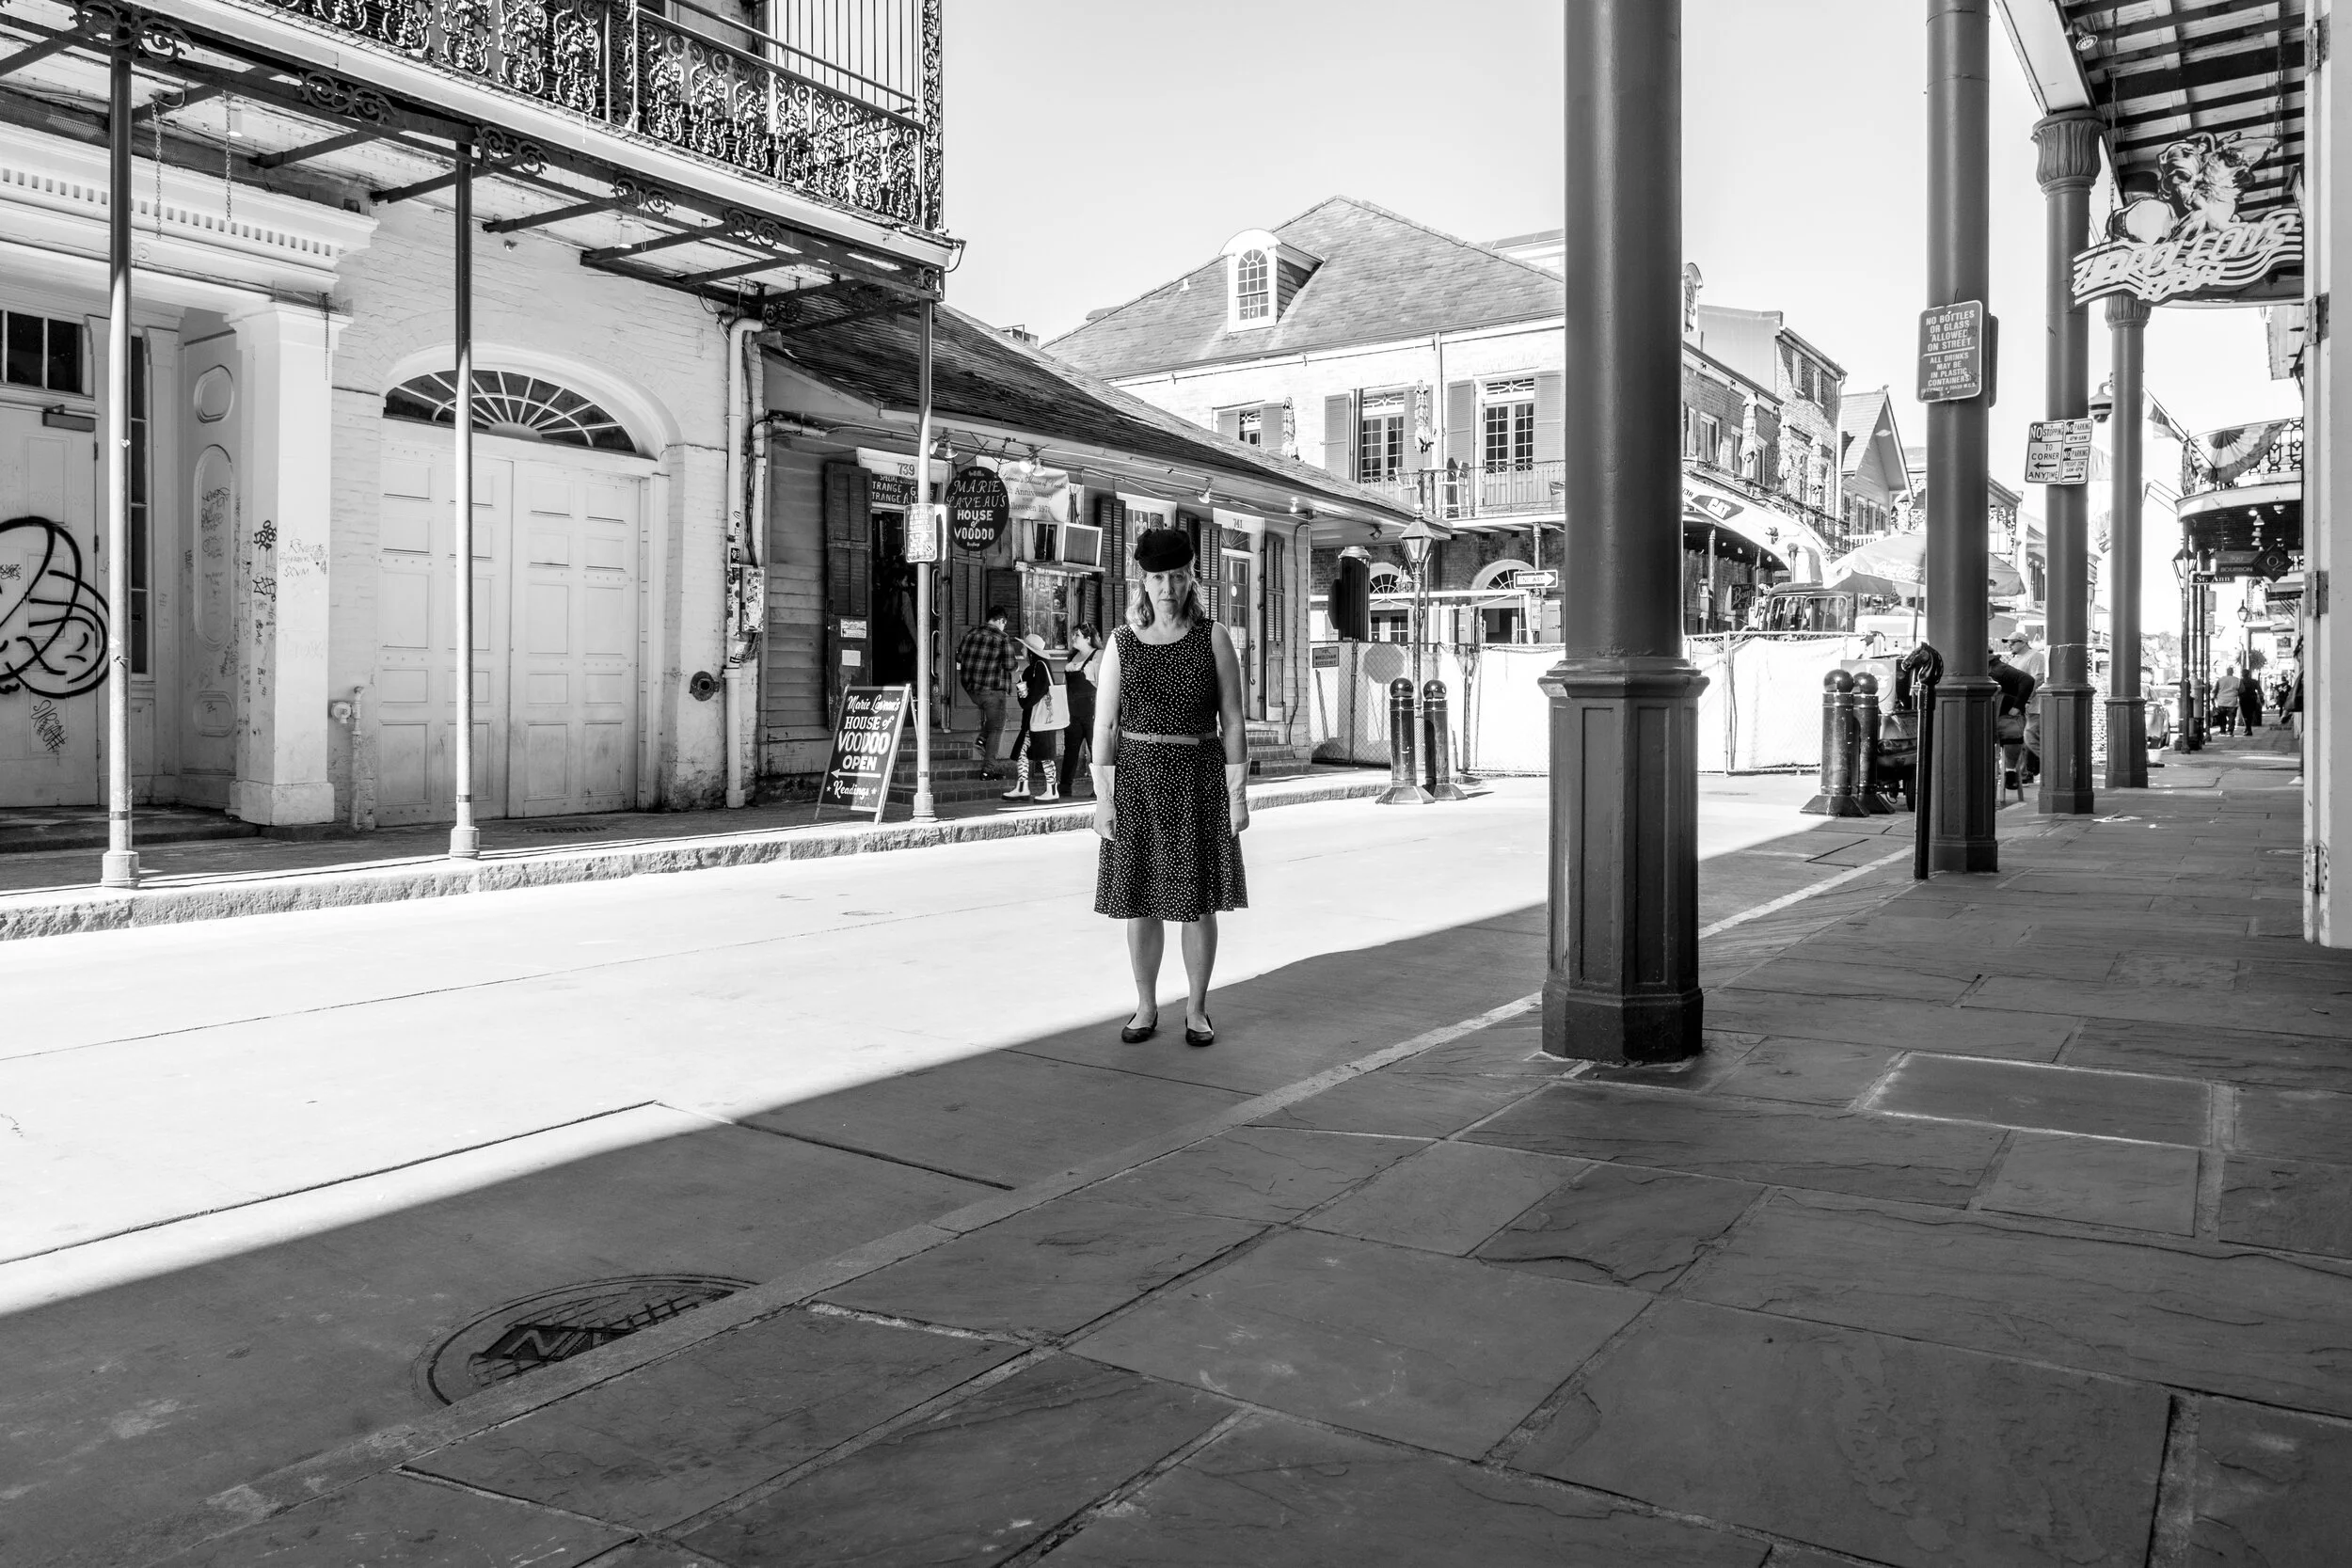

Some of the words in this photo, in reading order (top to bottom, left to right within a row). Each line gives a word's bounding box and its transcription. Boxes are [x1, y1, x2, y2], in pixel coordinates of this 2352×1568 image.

[1926, 316, 1937, 325] NO
[1939, 309, 1975, 324] BOTTLES
[1930, 325, 1941, 334] OR
[1944, 320, 1970, 331] GLASS
[1931, 329, 1968, 342] ALLOWED
[1927, 343, 1938, 352] ON
[1942, 337, 1971, 350] STREET
[1944, 352, 1969, 362] DRINKS
[1940, 368, 1967, 377] PLASTIC
[1928, 375, 1970, 387] CONTAINERS
[2030, 426, 2042, 439] NO
[2042, 427, 2064, 436] STOPPING
[2066, 424, 2074, 433] NO
[2074, 422, 2090, 431] PARKING
[2063, 451, 2071, 459] NO
[2072, 449, 2088, 457] PARKING
[898, 462, 915, 477] 739
[2028, 471, 2058, 480] ANYTIME
[872, 481, 902, 494] TRANGE
[952, 479, 1000, 495] MARIE
[1015, 487, 1054, 500] Anniversary
[871, 491, 901, 504] TRANGE
[946, 493, 1007, 508] LAVEAU'S
[1010, 502, 1036, 512] lloween
[1707, 498, 1732, 519] CAT
[957, 509, 993, 521] HOUSE
[970, 518, 980, 528] of
[1232, 518, 1243, 529] 741
[953, 526, 994, 541] VOODOO
[847, 695, 871, 713] Marie
[870, 694, 901, 714] Laveau's
[844, 716, 882, 731] HOUSE
[882, 715, 896, 730] of
[837, 730, 892, 755] VOODOO
[842, 754, 878, 771] OPEN
[833, 780, 869, 800] Readings
